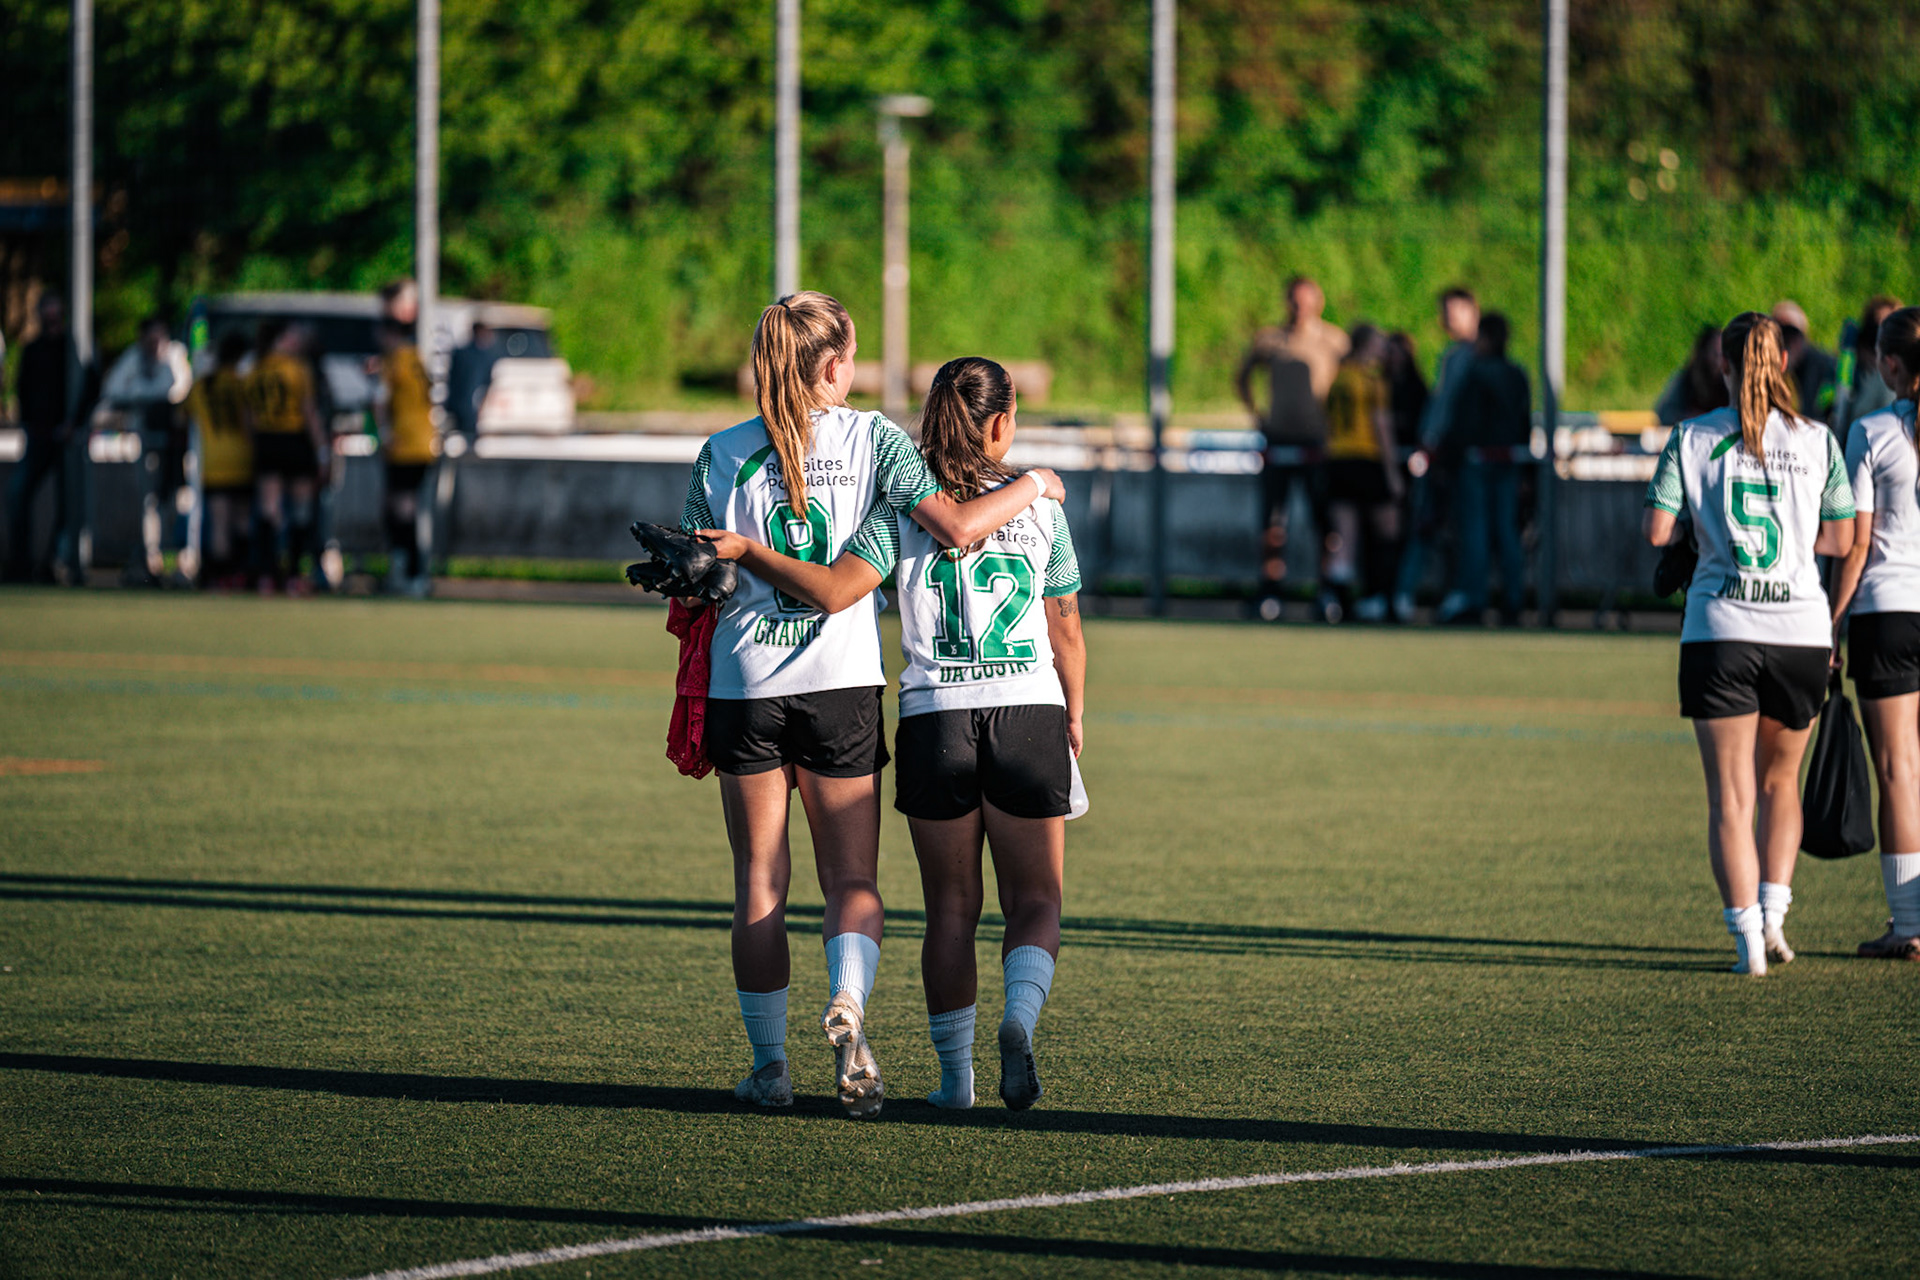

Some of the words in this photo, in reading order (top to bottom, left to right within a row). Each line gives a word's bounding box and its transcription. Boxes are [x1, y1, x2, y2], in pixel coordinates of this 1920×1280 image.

[766, 458, 843, 476] Reaites
[768, 472, 856, 491] Polaires
[1727, 476, 1782, 573] 5
[986, 529, 1037, 547] laires
[1751, 579, 1790, 602] DACH
[925, 547, 1036, 664] 12
